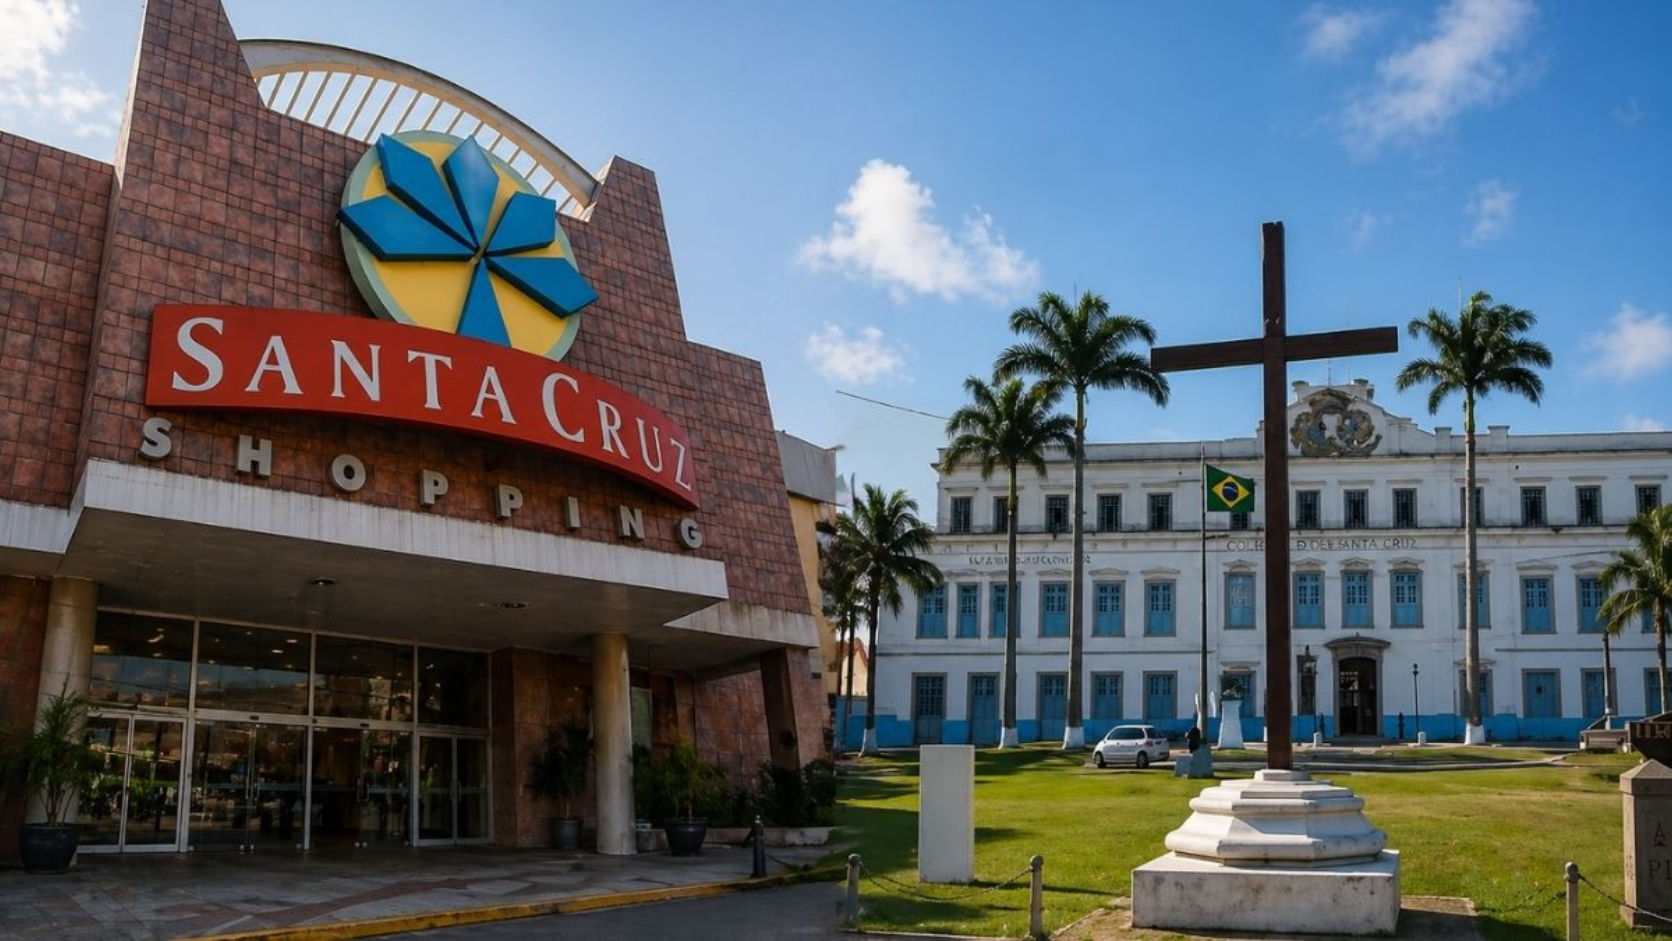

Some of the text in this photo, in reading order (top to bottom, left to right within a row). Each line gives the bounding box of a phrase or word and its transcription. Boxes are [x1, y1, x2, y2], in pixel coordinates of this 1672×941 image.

[172, 316, 692, 492] SANTA CRUZ
[139, 417, 703, 550] SHOPPING
[1337, 538, 1378, 551] SANTA
[1383, 537, 1417, 550] CRUZ
